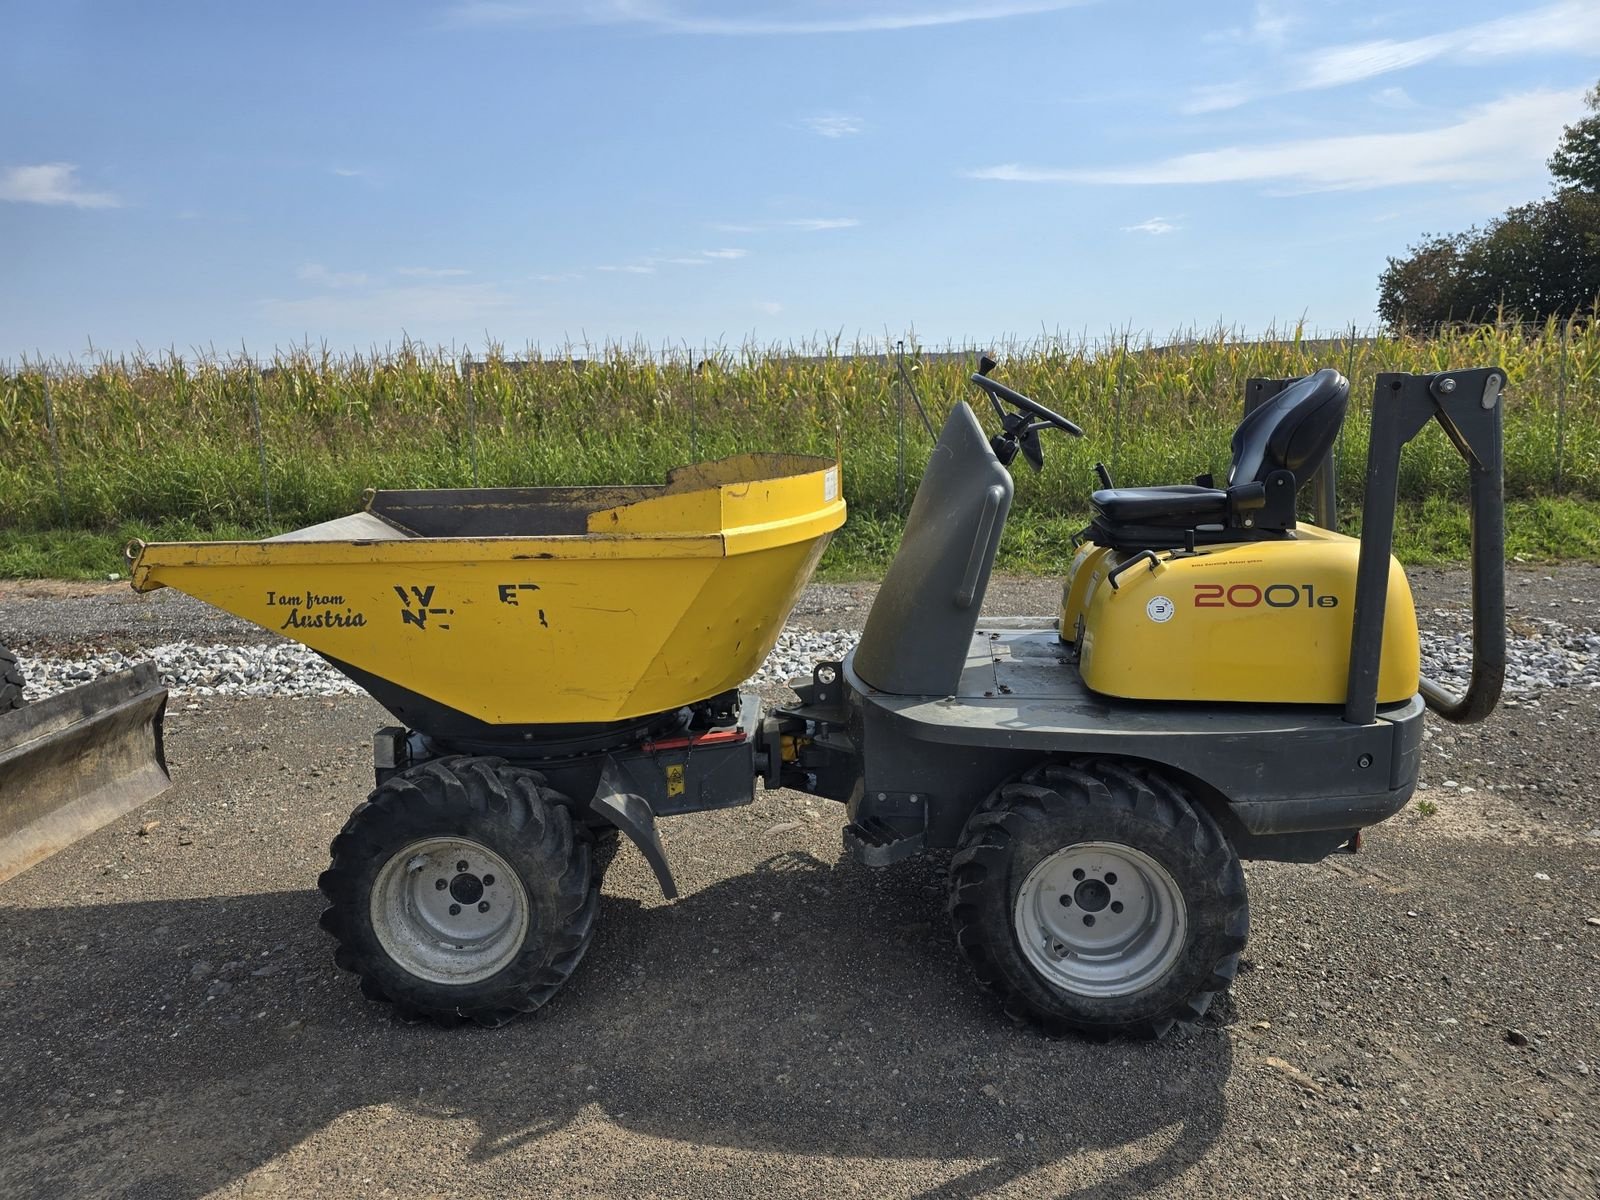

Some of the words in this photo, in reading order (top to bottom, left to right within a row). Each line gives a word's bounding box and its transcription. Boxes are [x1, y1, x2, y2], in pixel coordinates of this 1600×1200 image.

[266, 592, 276, 606] I
[279, 595, 303, 606] am
[306, 591, 346, 610] from
[280, 608, 368, 630] Austria
